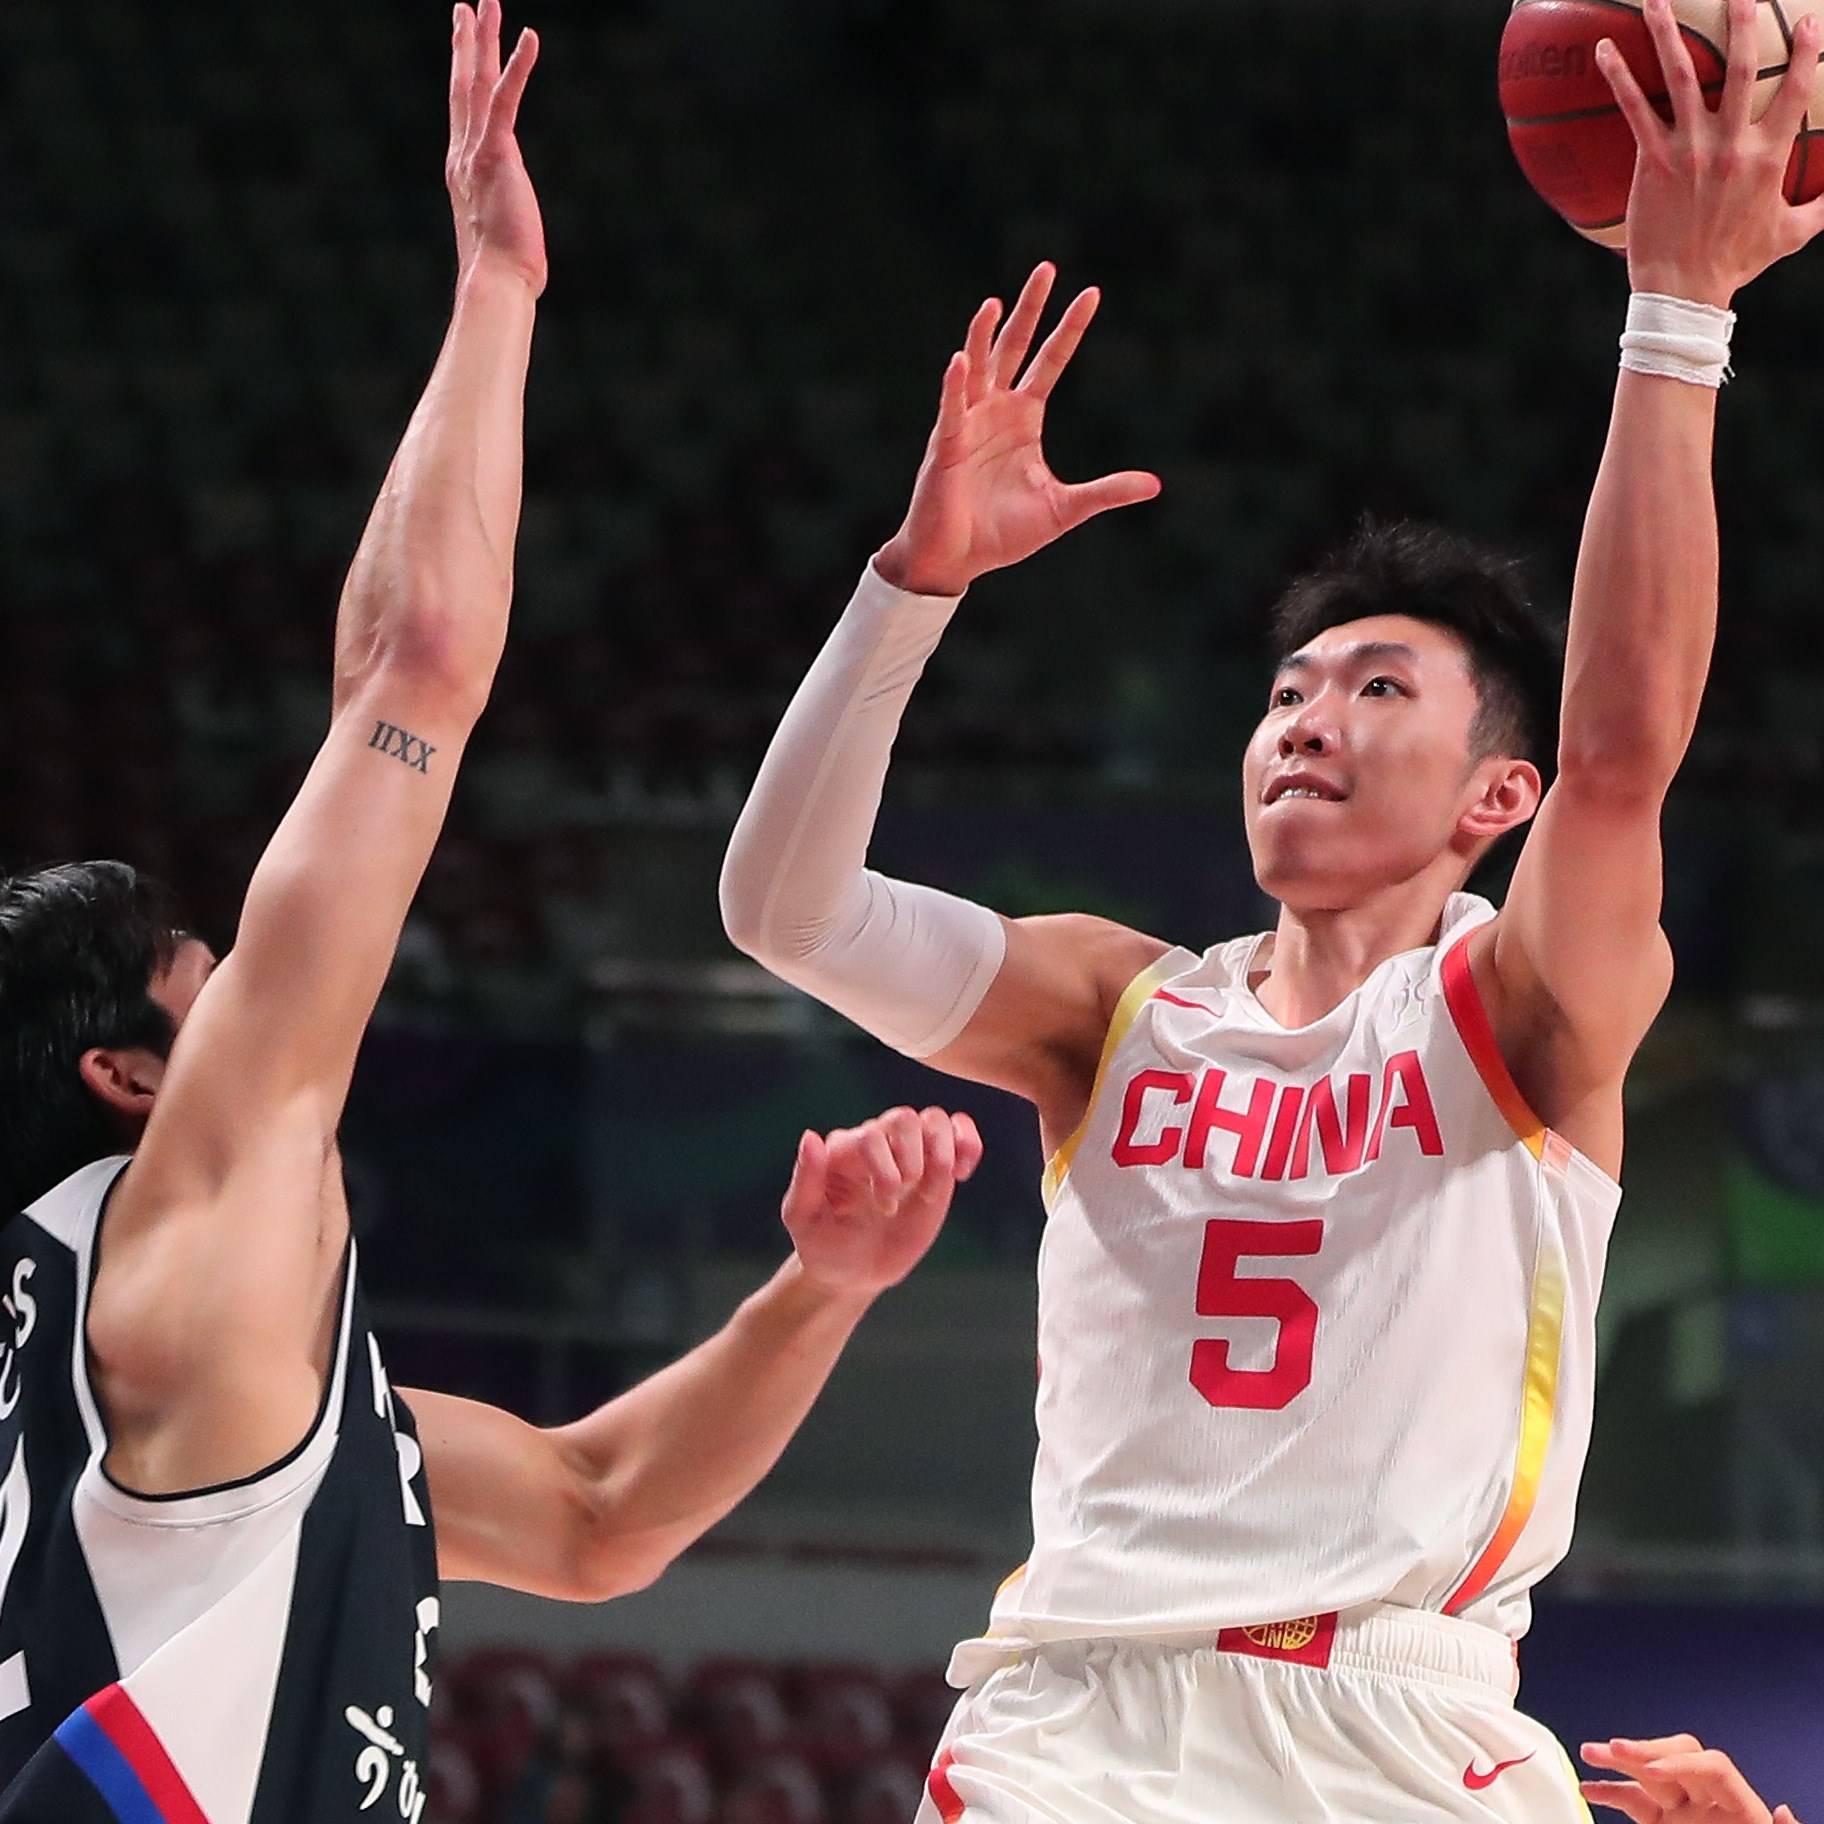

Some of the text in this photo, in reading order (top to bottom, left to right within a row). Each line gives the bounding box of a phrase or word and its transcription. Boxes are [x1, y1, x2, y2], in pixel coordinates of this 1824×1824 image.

[368, 721, 436, 774] IIXX
[1111, 1050, 1443, 1180] CHINA
[1189, 1219, 1323, 1411] 5
